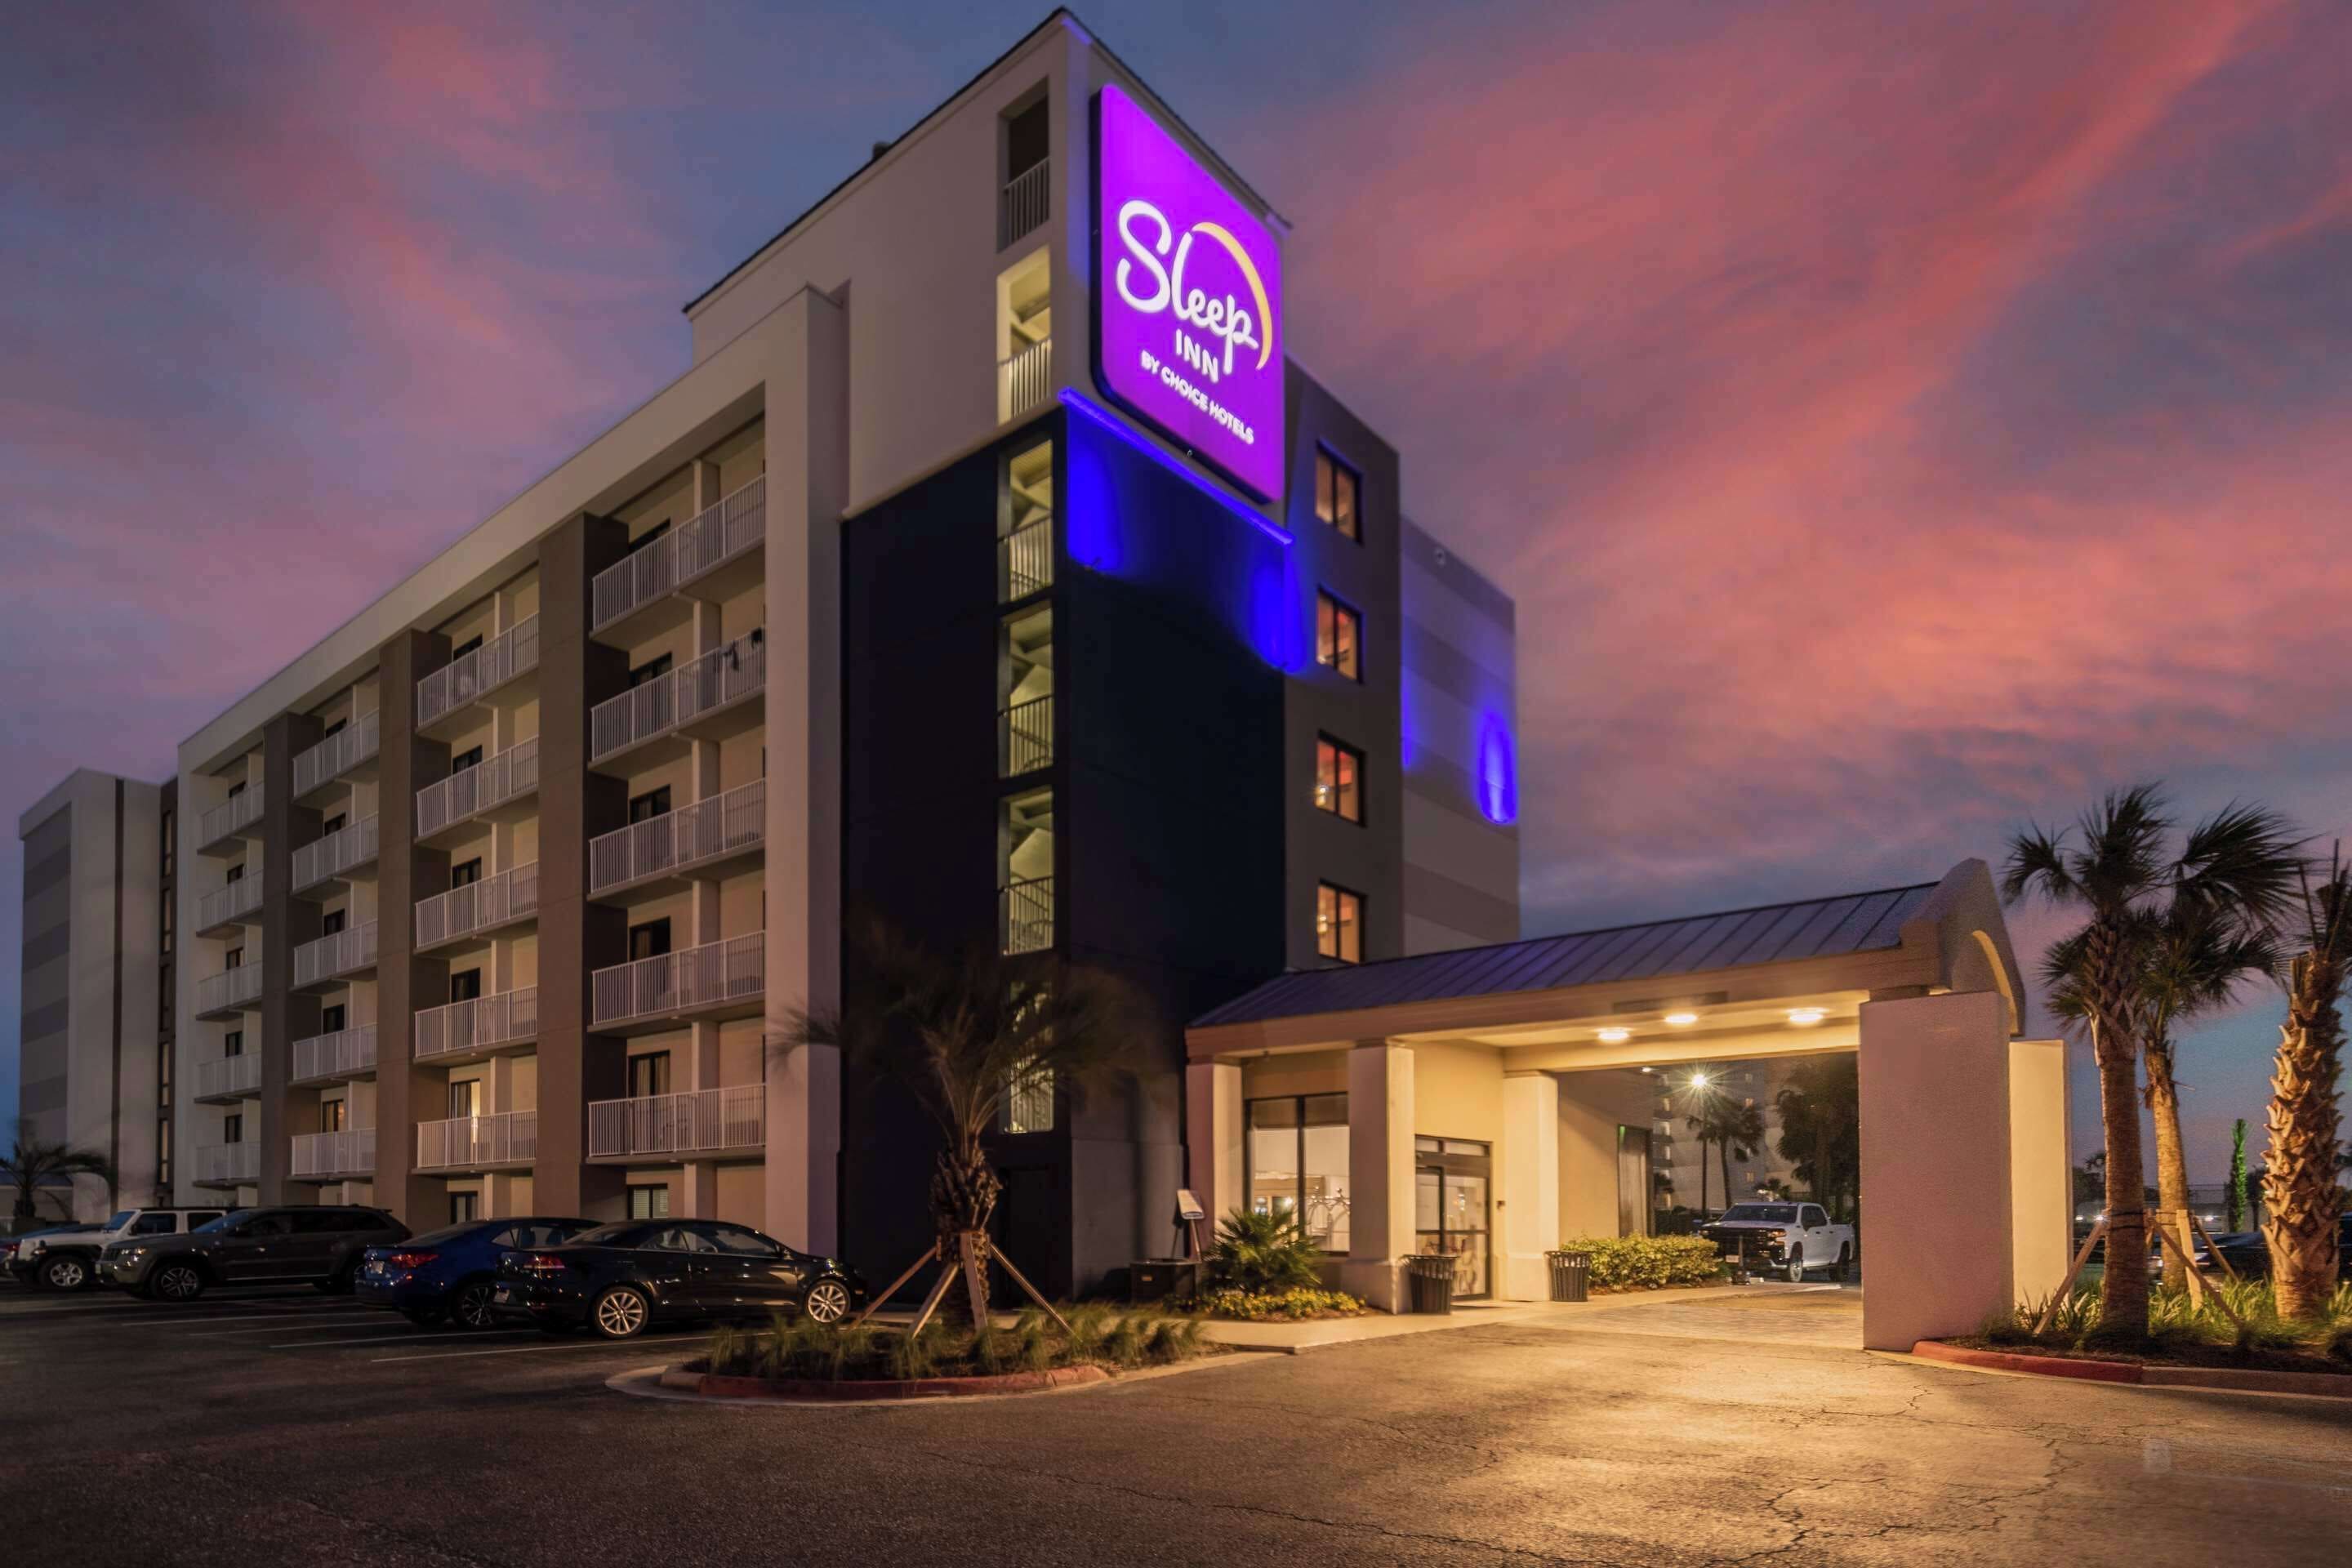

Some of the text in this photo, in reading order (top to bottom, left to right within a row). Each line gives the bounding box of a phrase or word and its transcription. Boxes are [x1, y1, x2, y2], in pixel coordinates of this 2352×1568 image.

[1116, 200, 1258, 374] Sleep
[1142, 350, 1254, 444] BY CHOICE HOTELS
[1176, 329, 1218, 382] INN
